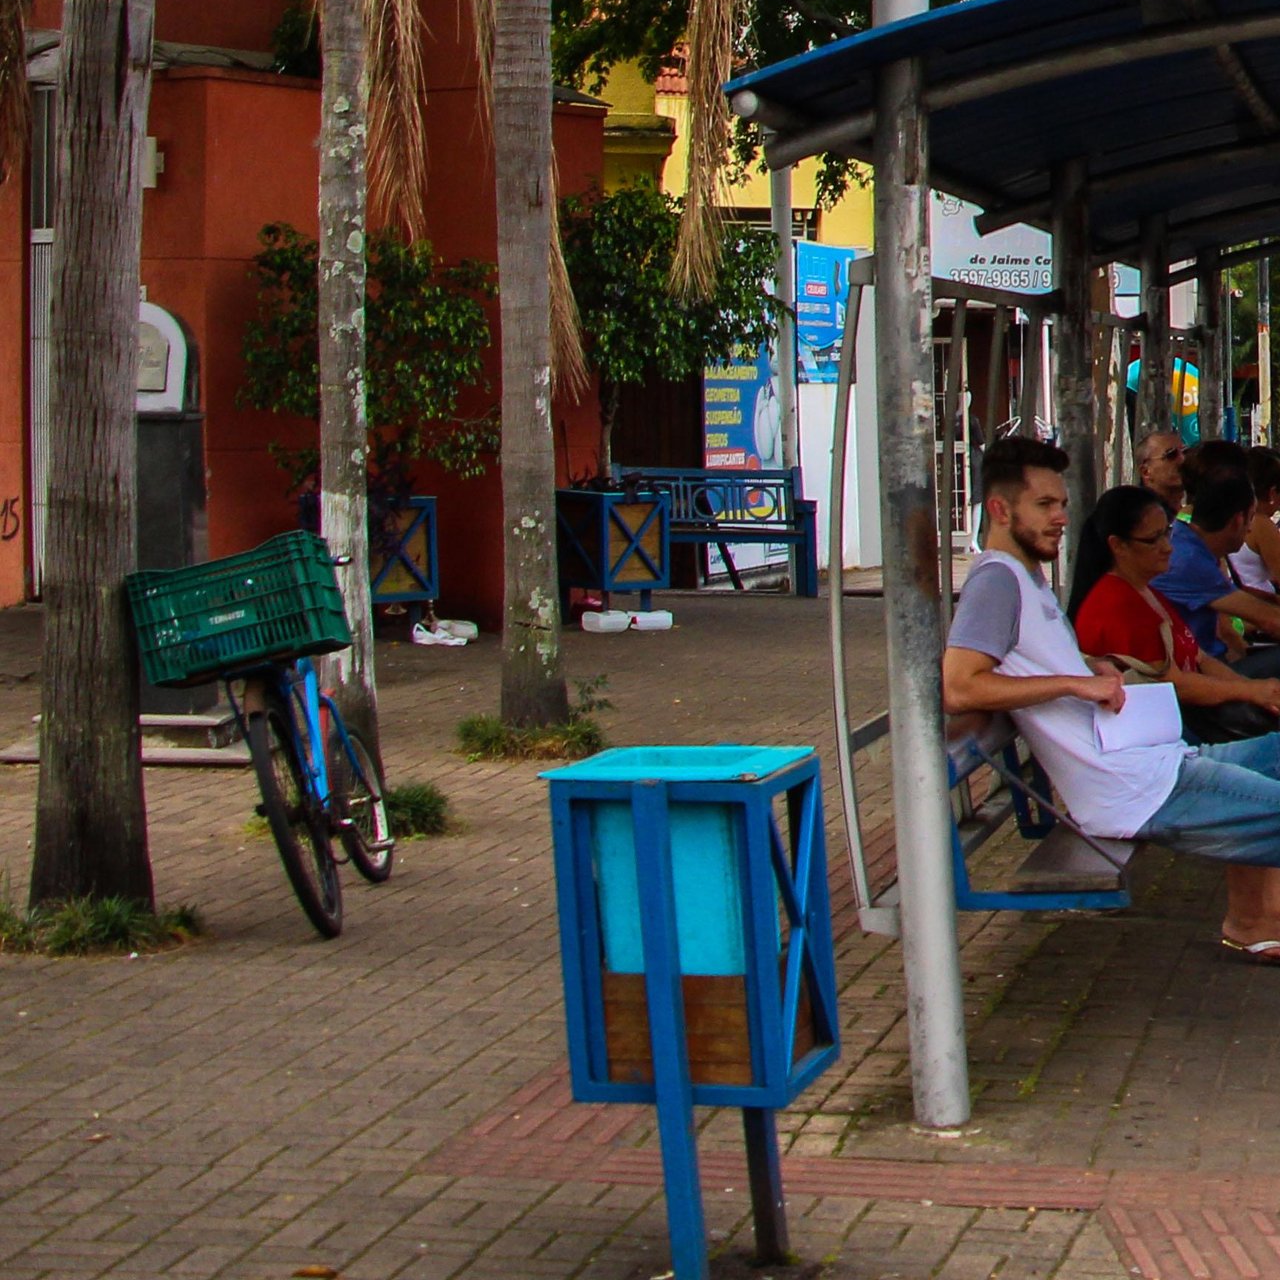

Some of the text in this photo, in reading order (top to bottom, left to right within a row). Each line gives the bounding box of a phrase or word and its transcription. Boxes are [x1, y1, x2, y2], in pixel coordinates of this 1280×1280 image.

[969, 253, 1053, 266] de Jaime Ca
[949, 269, 1029, 287] 3597-9865
